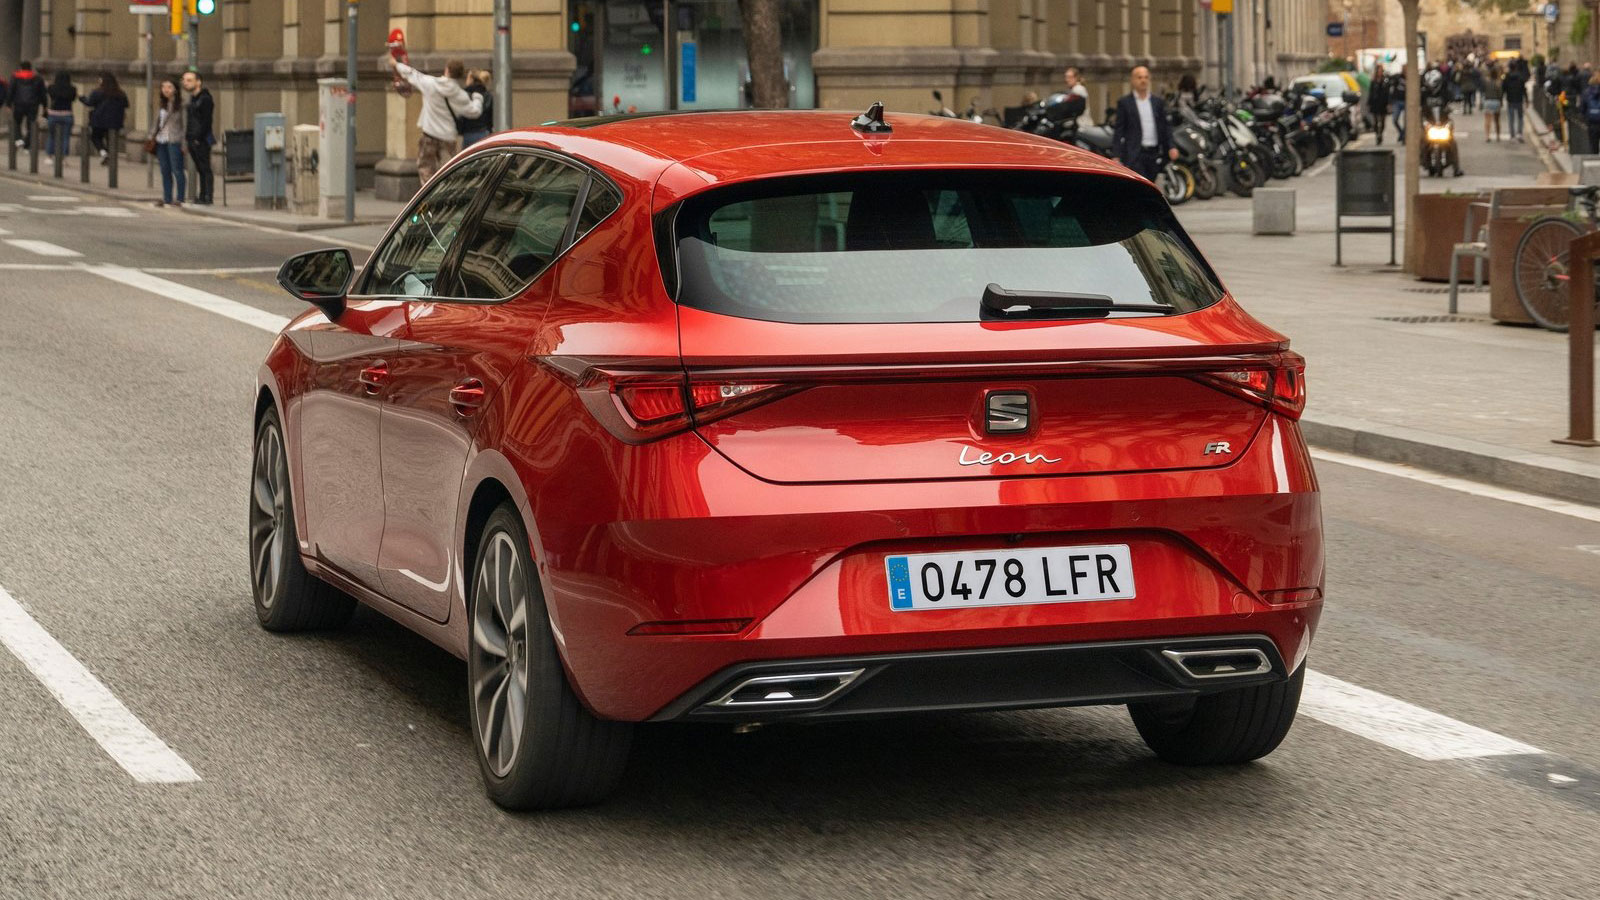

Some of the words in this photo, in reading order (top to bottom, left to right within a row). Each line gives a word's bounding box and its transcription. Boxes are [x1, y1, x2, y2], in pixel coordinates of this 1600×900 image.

[959, 445, 1062, 465] Leon
[1203, 441, 1232, 455] FR
[920, 557, 1027, 602] 0478
[1041, 553, 1121, 597] LFR
[897, 588, 906, 600] E
